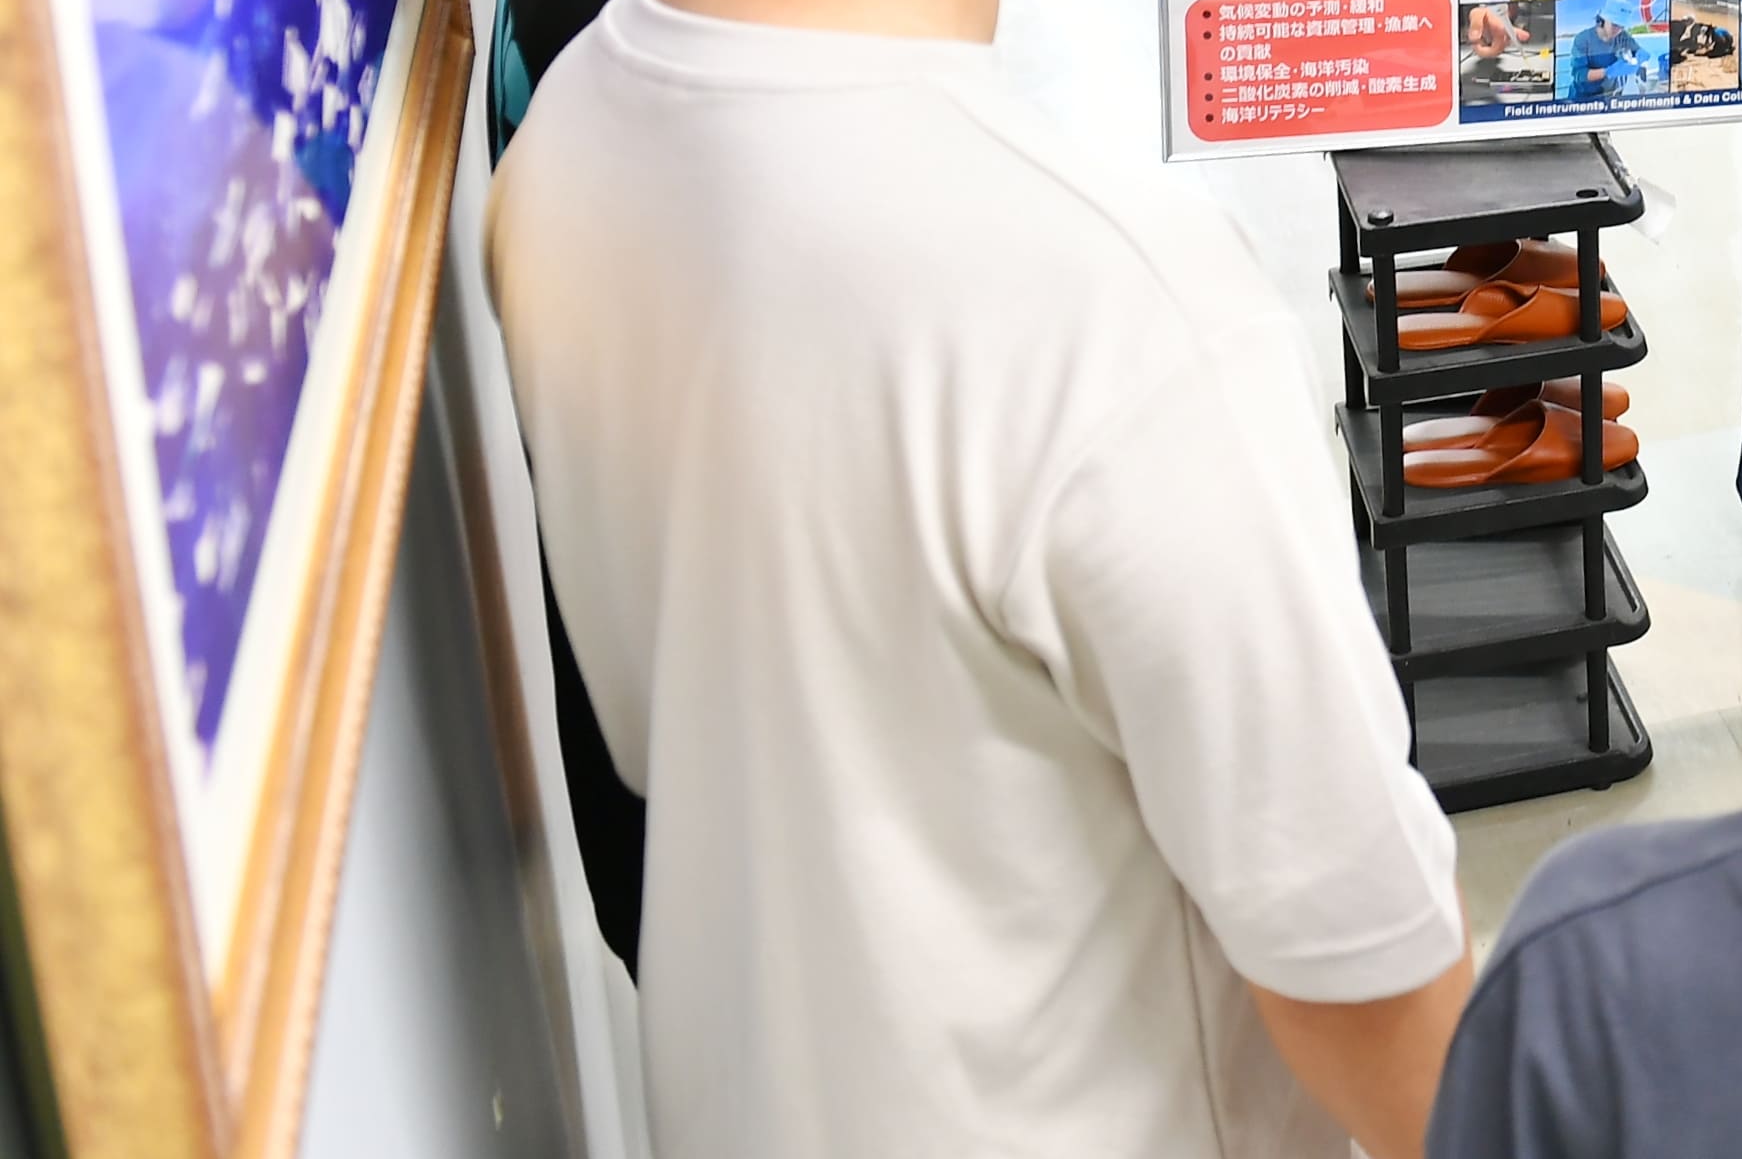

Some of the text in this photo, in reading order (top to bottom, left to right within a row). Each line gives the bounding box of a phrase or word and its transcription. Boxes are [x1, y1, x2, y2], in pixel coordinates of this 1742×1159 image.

[1220, 43, 1272, 62] の貢献
[1222, 103, 1325, 124] 海洋リテラシー
[1504, 105, 1533, 117] Field
[1535, 101, 1609, 116] Instruments,
[1611, 97, 1680, 112] Experiments
[1683, 94, 1692, 105] &
[1694, 92, 1720, 105] Data
